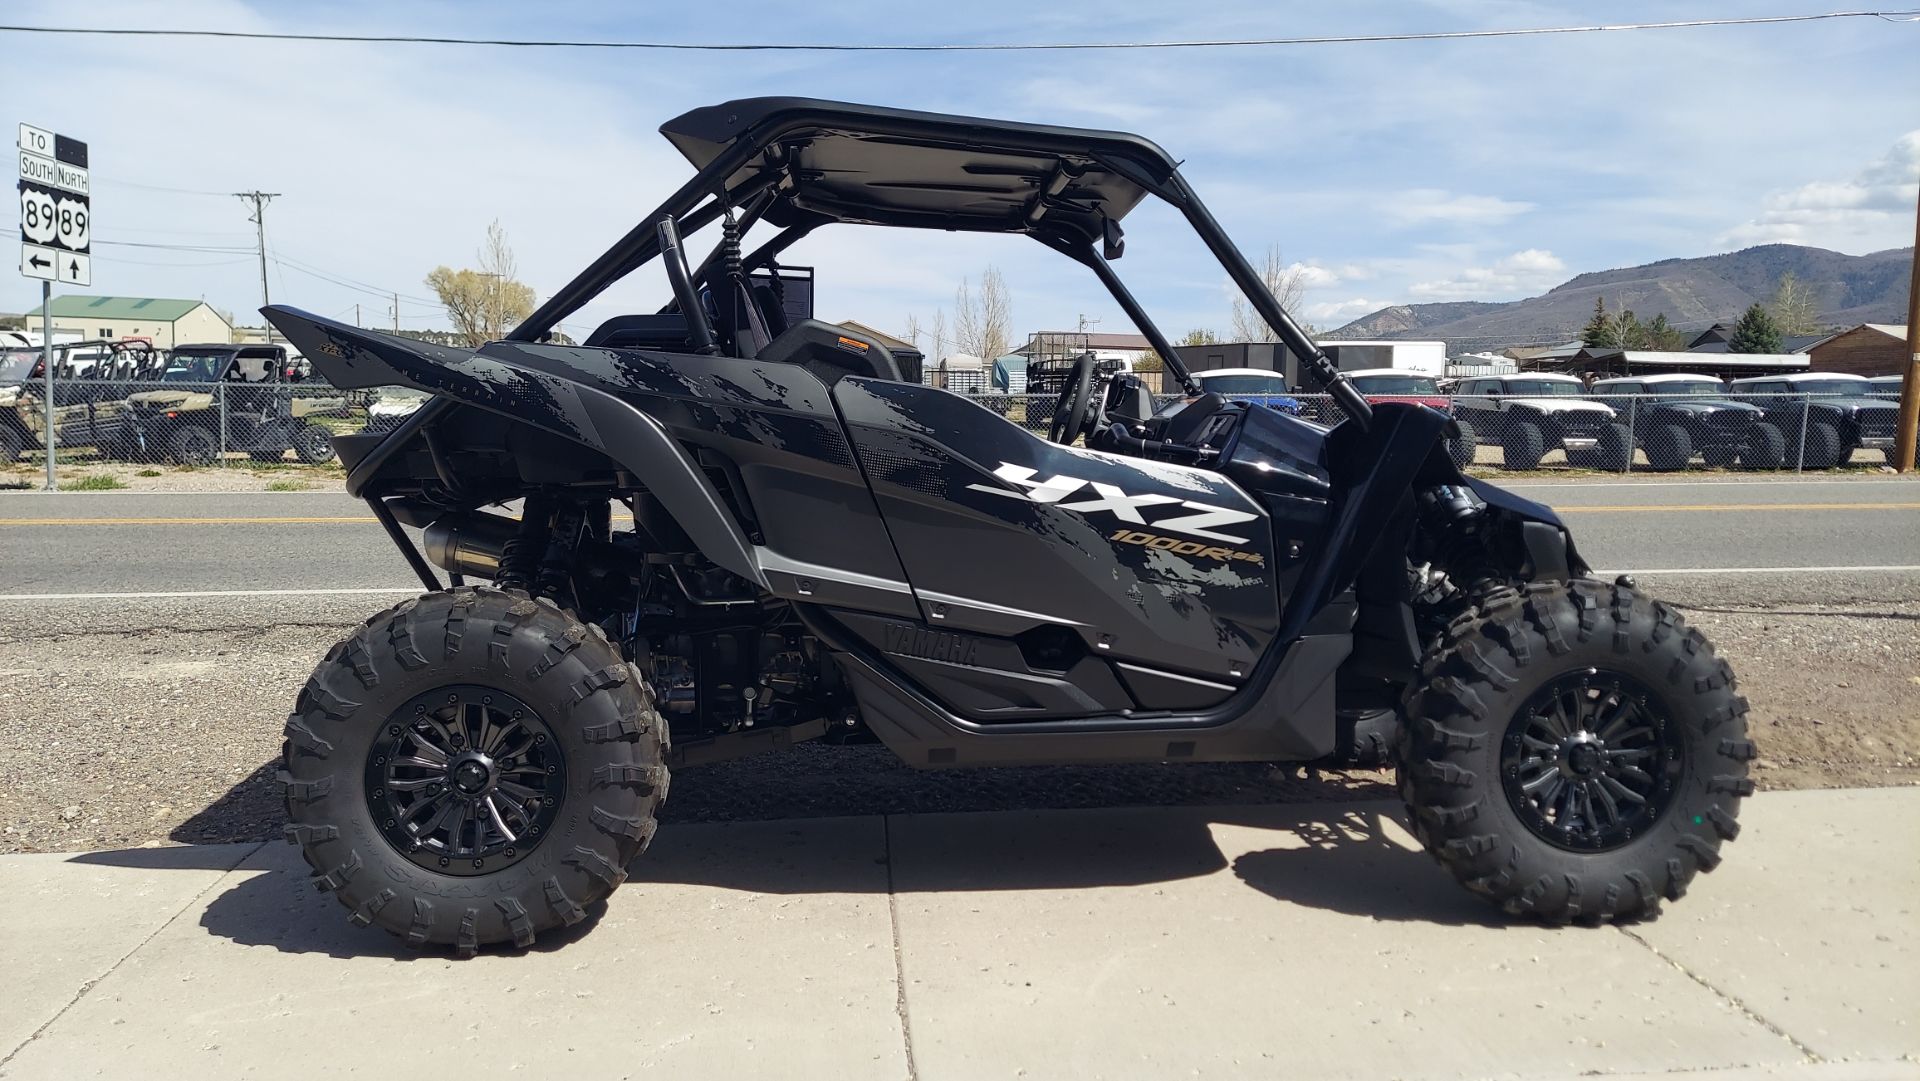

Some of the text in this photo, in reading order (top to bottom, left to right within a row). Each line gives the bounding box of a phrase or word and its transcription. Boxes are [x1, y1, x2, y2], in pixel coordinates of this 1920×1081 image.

[29, 131, 46, 150] TO
[22, 157, 54, 181] SOUTH
[58, 165, 87, 188] NORTH
[26, 200, 53, 231] 89
[61, 209, 86, 238] 89
[438, 380, 516, 407] TERRAIN
[966, 461, 1260, 544] YXZ
[884, 623, 980, 665] YAMAHA
